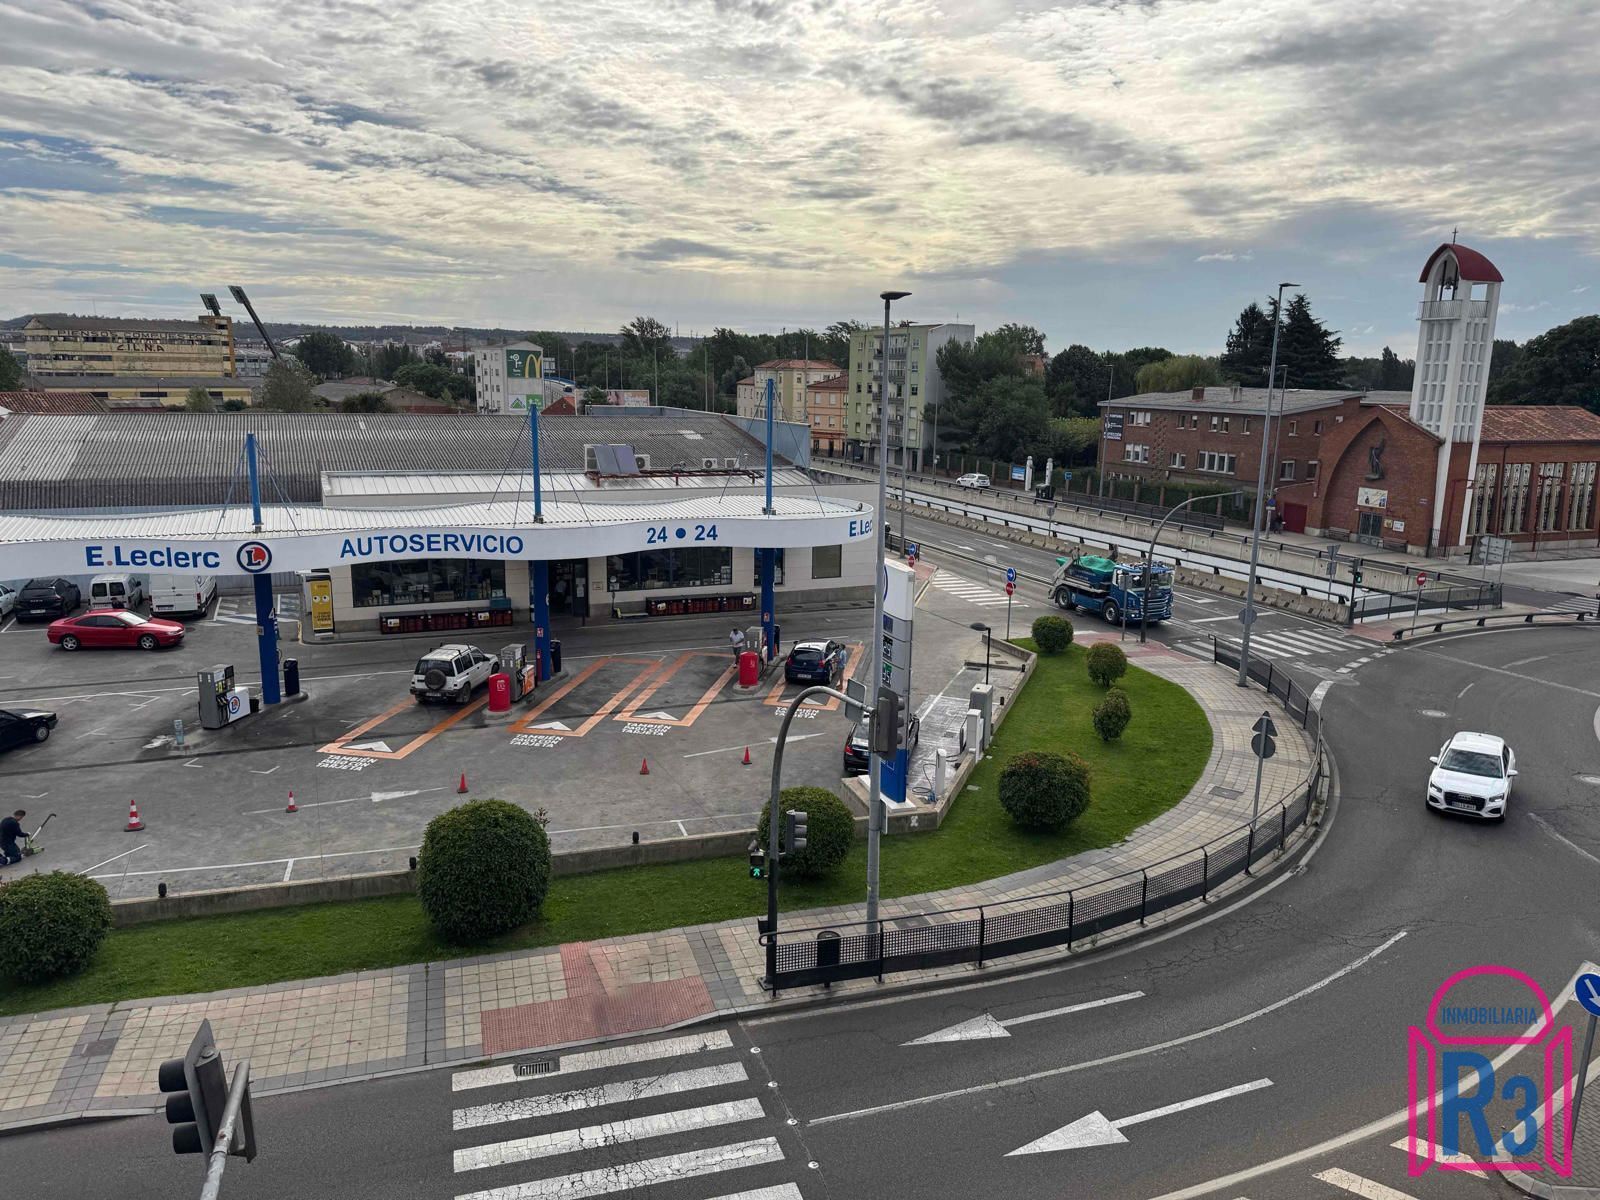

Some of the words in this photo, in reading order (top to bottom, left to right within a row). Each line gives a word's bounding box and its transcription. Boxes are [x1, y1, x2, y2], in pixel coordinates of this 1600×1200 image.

[340, 533, 524, 558] AUTOSERVICIO
[647, 526, 668, 544] 24
[694, 524, 718, 541] 24
[85, 545, 220, 568] E.Leclerc
